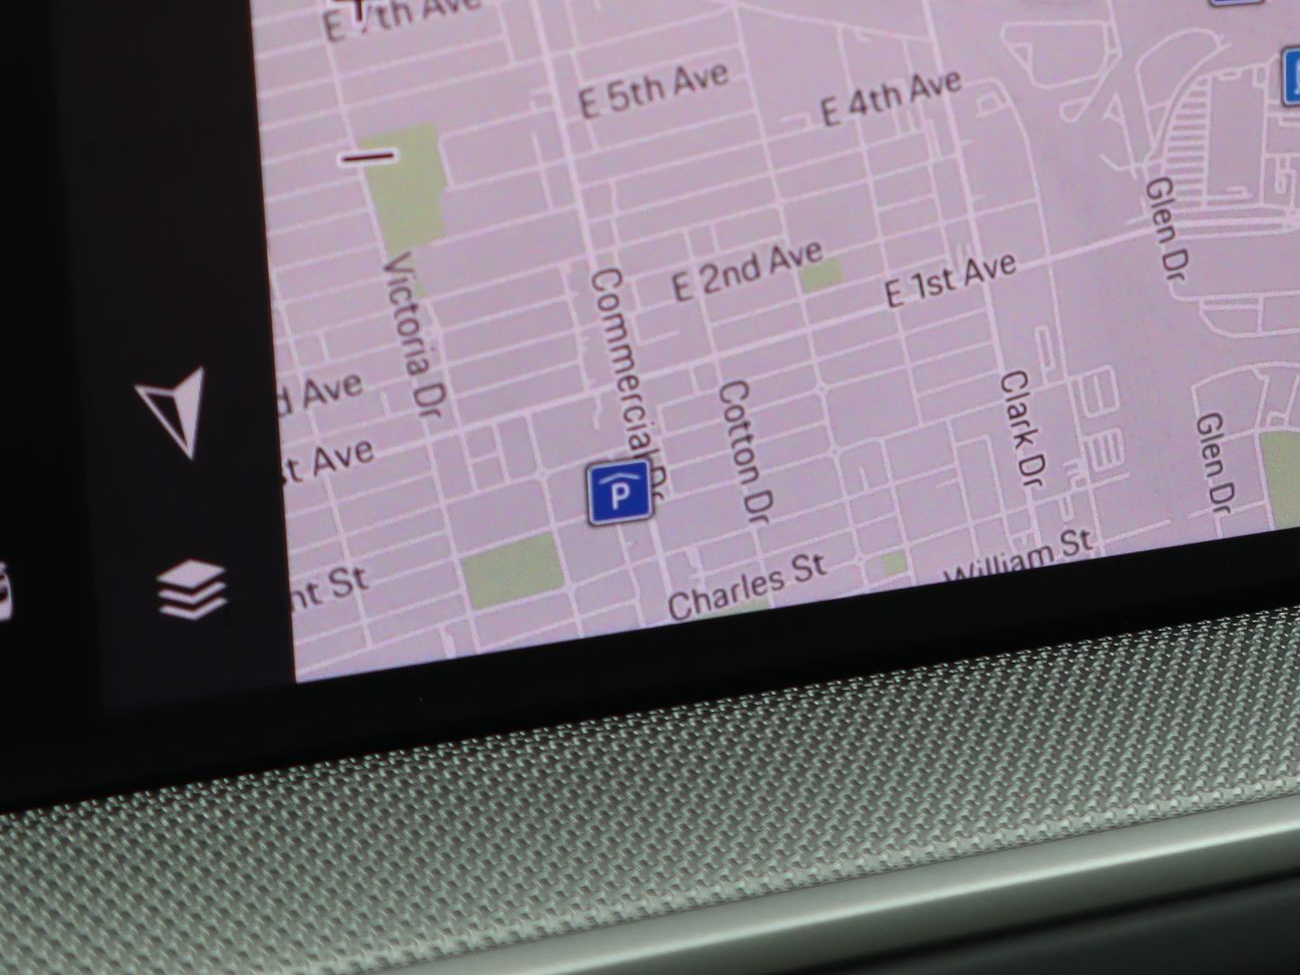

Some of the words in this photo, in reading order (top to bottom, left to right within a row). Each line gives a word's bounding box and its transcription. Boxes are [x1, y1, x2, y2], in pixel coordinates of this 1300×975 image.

[323, 10, 346, 43] E
[579, 88, 600, 119] E
[608, 74, 665, 112] 5th
[673, 63, 730, 95] Ave
[821, 97, 843, 127] E
[849, 83, 901, 116] 4th
[909, 70, 963, 102] Ave
[1146, 175, 1177, 245] Glen
[1162, 248, 1190, 282] Dr
[673, 272, 693, 302] E
[701, 254, 760, 294] 2nd
[769, 239, 823, 273] Ave
[885, 279, 904, 309] E
[910, 269, 953, 300] 1st
[964, 252, 1017, 286] Ave
[383, 252, 433, 376] Victoria
[413, 382, 446, 419] Dr
[303, 374, 363, 409] Ave
[1001, 370, 1039, 449] Clark
[314, 440, 374, 476] Ave
[719, 379, 760, 486] Cotton
[744, 490, 774, 524] Dr
[1019, 454, 1047, 489] Dr
[1197, 411, 1224, 478] Glen
[1208, 482, 1237, 516] Dr
[1061, 529, 1093, 557] St
[329, 566, 369, 598] St
[669, 571, 785, 622] Charles
[792, 553, 828, 583] St
